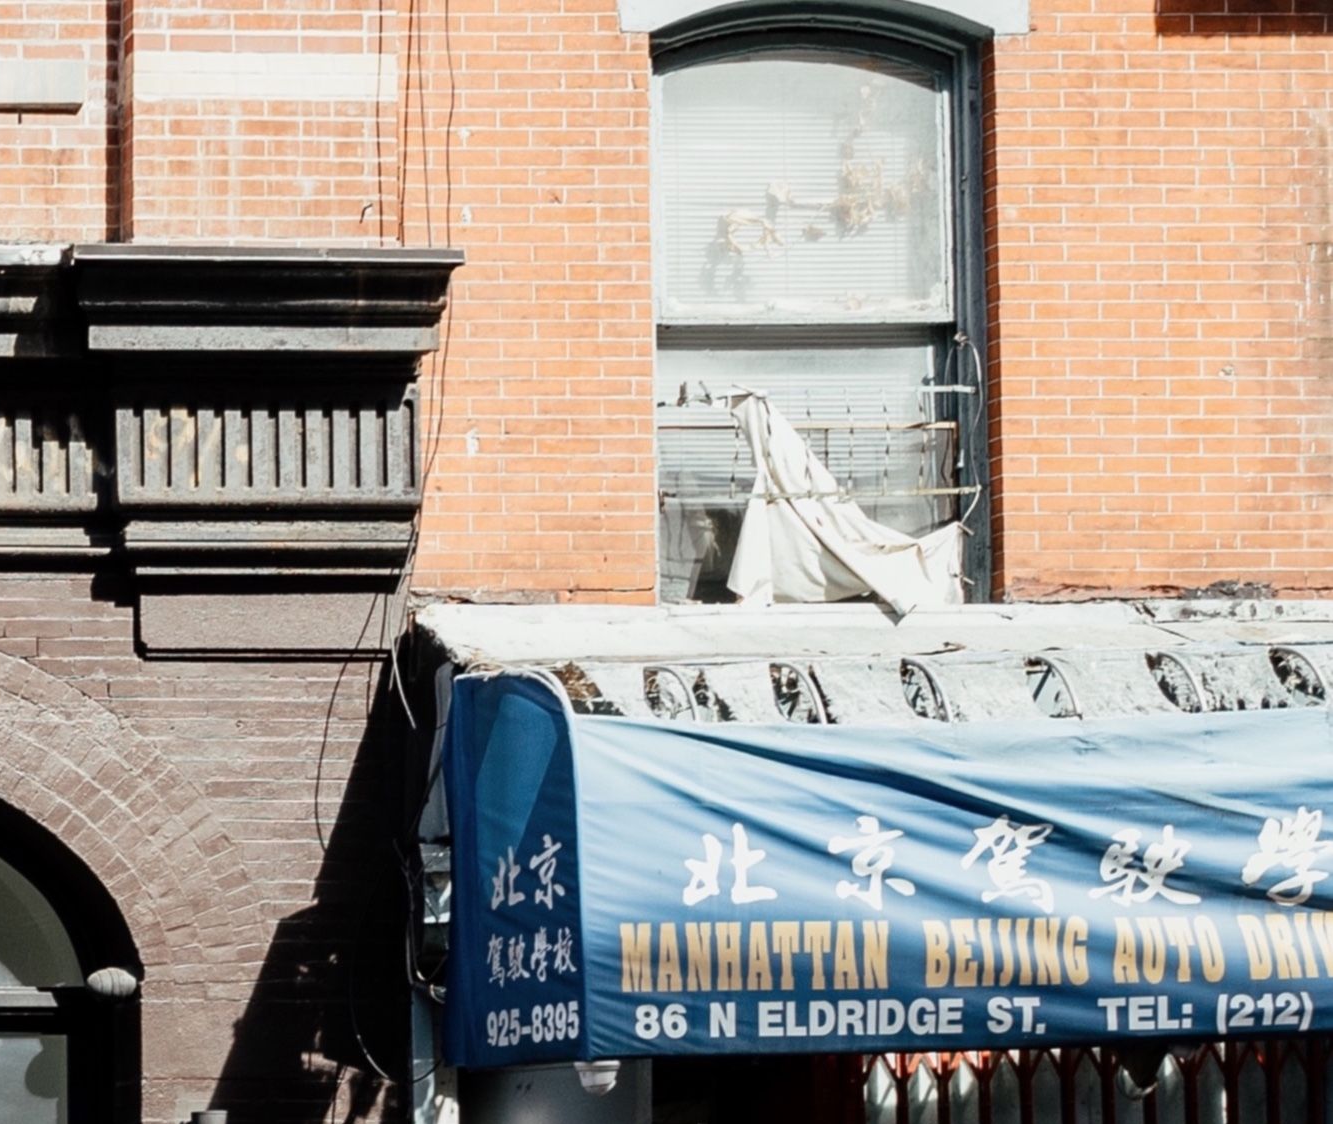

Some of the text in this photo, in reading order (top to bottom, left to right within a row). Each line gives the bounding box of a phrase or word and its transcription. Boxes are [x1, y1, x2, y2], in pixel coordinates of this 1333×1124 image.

[620, 920, 889, 993] MANHATTAN
[922, 915, 1089, 988] BEIJING
[1113, 915, 1226, 985] AUTO
[486, 1000, 580, 1047] 925-8395
[635, 991, 1314, 1039] 86 N ELDRIDGE ST. TEL: (212)
